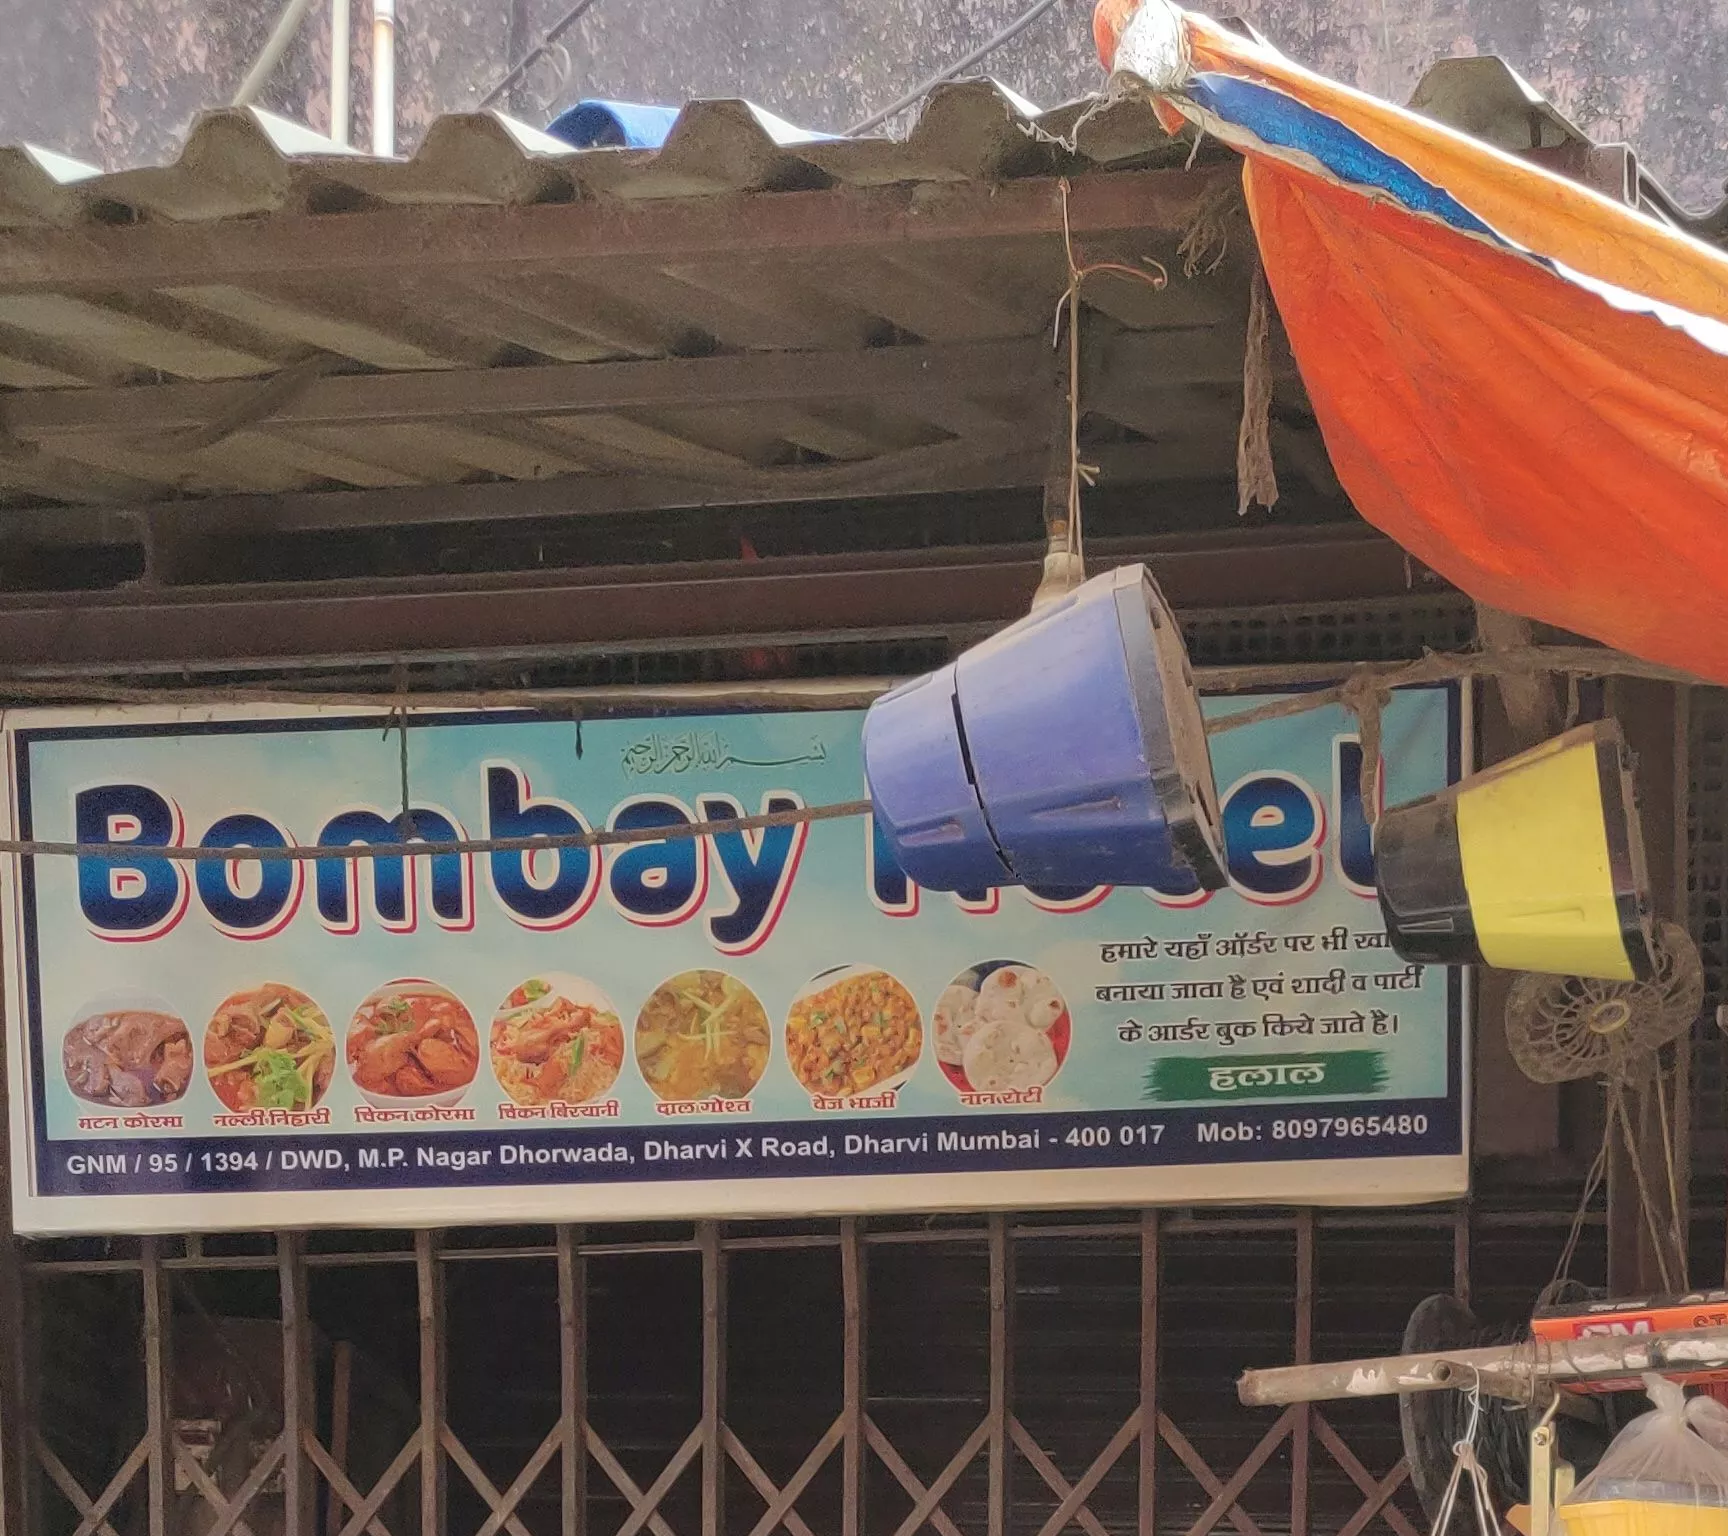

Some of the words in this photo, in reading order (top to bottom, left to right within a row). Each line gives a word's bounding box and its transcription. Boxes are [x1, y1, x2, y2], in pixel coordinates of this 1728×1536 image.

[73, 758, 806, 957] Bombay
[1101, 936, 1158, 962] हमारे
[1284, 935, 1316, 952] पर
[1322, 927, 1348, 951] भी
[1096, 984, 1164, 1001] बनाया
[1171, 982, 1224, 999] जाता
[1229, 975, 1246, 998] है
[1252, 972, 1284, 1001] एवं
[1291, 968, 1345, 994] शादी
[1352, 974, 1366, 990] व
[1374, 963, 1424, 990] पार्टी
[1118, 1020, 1142, 1042] के
[1216, 1022, 1257, 1046] बुक
[1263, 1012, 1315, 1037] किये
[1320, 1014, 1366, 1034] जाते
[1208, 1062, 1327, 1091] हलाल
[813, 1094, 845, 1111] वेज
[850, 1091, 896, 1109] भाजी
[960, 1090, 998, 1105] नान
[1002, 1086, 1043, 1104] रोटी
[213, 1108, 265, 1128] नल्ली
[269, 1107, 331, 1127] निहारी
[355, 1106, 409, 1123] चिकन
[413, 1104, 475, 1121] कोरमा
[499, 1103, 547, 1119] चिकन
[551, 1100, 619, 1119] बिरयानी
[656, 1100, 695, 1116] दाल
[698, 1098, 752, 1114] गोश्त
[78, 1118, 119, 1130] मटन
[124, 1114, 184, 1128] कोरमा
[66, 1154, 127, 1175] GNM
[149, 1153, 178, 1173] 95
[200, 1151, 258, 1172] 1394
[281, 1150, 350, 1171] DWD,
[358, 1147, 408, 1168] M.P.
[417, 1145, 492, 1172] Nagar
[500, 1142, 636, 1166] Dhorwada,
[644, 1138, 727, 1161] Dharvi
[735, 1138, 752, 1158] X
[761, 1134, 836, 1159] Road,
[844, 1131, 928, 1155] Dharvi
[937, 1128, 1040, 1152] Mumbai
[1065, 1127, 1111, 1147] 400
[1119, 1125, 1166, 1145] 017
[1197, 1122, 1262, 1143] Mob:
[1271, 1115, 1428, 1140] 8097965480
